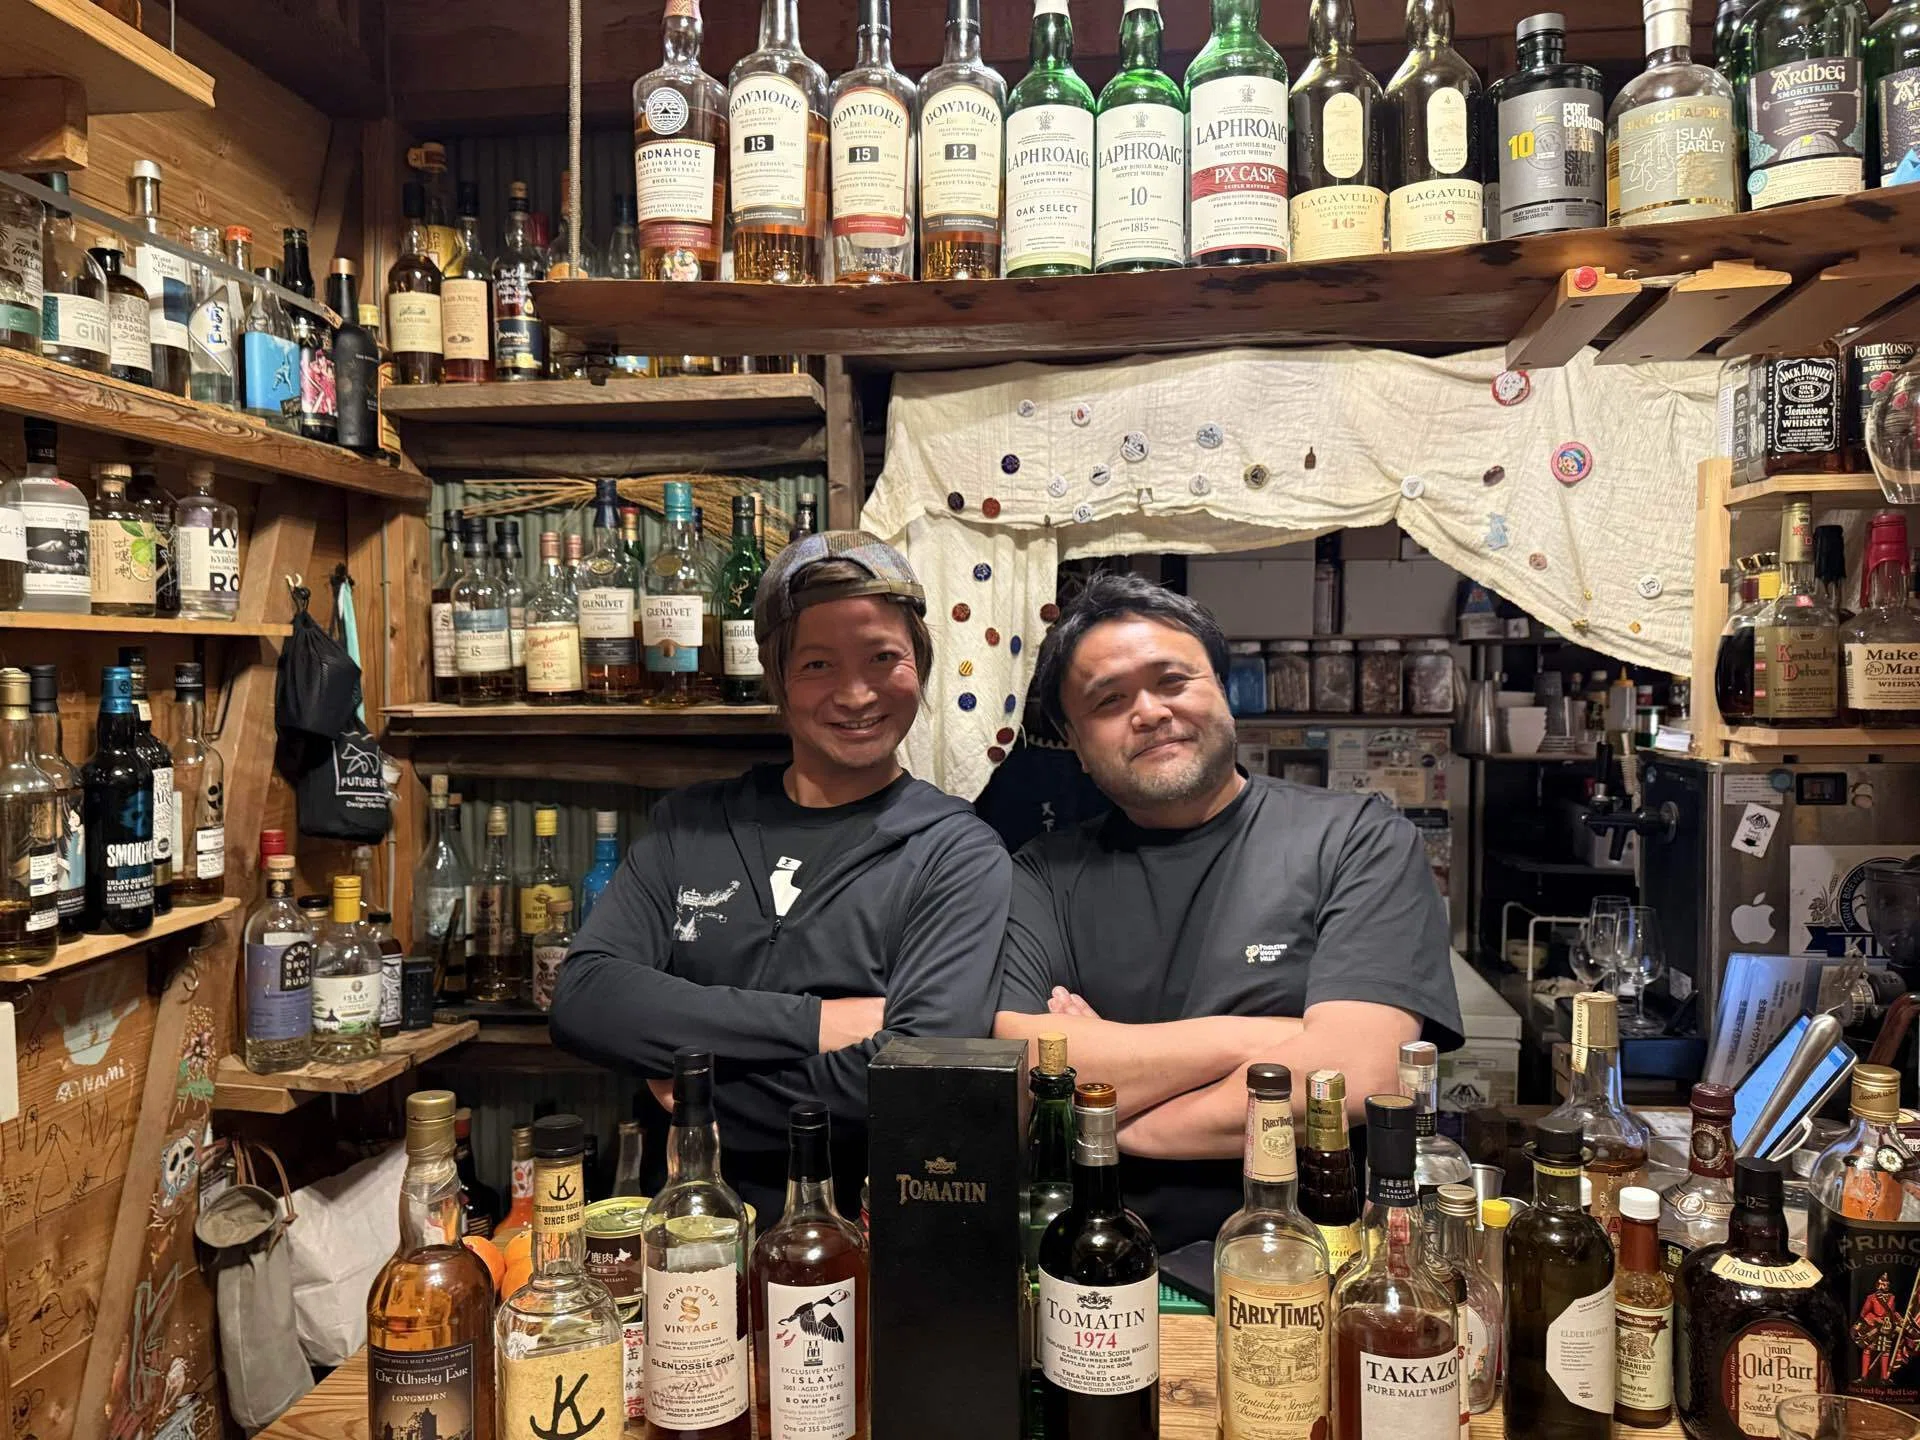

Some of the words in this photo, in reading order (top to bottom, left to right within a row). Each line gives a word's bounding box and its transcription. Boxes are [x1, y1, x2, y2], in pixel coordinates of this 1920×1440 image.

[1776, 84, 1840, 99] SMOKETRAILS
[730, 90, 802, 118] BOWMORE
[1562, 103, 1590, 116] PORT
[832, 103, 904, 129] BOWMORE
[926, 101, 998, 127] BOWMORE
[1197, 118, 1287, 145] LAPHROAIG
[1562, 115, 1604, 135] CHARLOTTE
[1676, 127, 1714, 141] ISLAY
[750, 137, 766, 151] 15
[1262, 143, 1276, 151] MALT
[1508, 130, 1535, 160] 10
[1676, 141, 1726, 154] BARLEY
[638, 149, 701, 162] ARDNAHOE
[855, 149, 871, 161] 15
[952, 145, 969, 159] 12
[1100, 143, 1182, 168] LAPHROAIG
[1008, 147, 1091, 172] LAPHROAIG
[1215, 167, 1237, 184] PX
[1239, 165, 1277, 184] CASK
[1129, 186, 1148, 206] 10
[1301, 193, 1379, 209] LAGAVULIN
[1406, 189, 1482, 203] LAGAVULIN
[1016, 206, 1035, 217] OAK
[1040, 204, 1078, 213] SELECT
[1444, 210, 1456, 224] 8
[1130, 222, 1149, 232] 1815
[1331, 218, 1356, 229] 16
[76, 321, 107, 345] GIN
[1779, 366, 1801, 383] JACK
[1801, 363, 1833, 381] DANIEL'S
[1784, 405, 1828, 416] Tennessee
[1782, 419, 1830, 428] WHISKEY
[582, 600, 624, 609] GLENLIVET
[646, 607, 692, 617] GLENLIVET
[661, 618, 673, 628] 12
[471, 647, 481, 656] 15
[1776, 643, 1836, 663] Kentucky
[1866, 649, 1920, 660] Make
[1783, 662, 1829, 681] Deluxe
[1885, 664, 1920, 674] Mar
[341, 776, 378, 787] FUTURE
[1262, 1118, 1280, 1132] EARLY
[896, 1174, 987, 1205] TOMATIN
[544, 1215, 565, 1226] SINCE
[591, 1251, 614, 1264] 鹿肉
[1722, 1261, 1760, 1281] Grand
[1763, 1269, 1784, 1283] Old
[1785, 1267, 1811, 1285] Parr
[662, 1285, 720, 1311] SIGNATORY
[1046, 1297, 1145, 1329] TOMATIN
[1229, 1295, 1278, 1331] EARLY
[1274, 1301, 1325, 1331] TIMES
[664, 1321, 718, 1333] VINTAGE
[1561, 1329, 1585, 1338] ELDER
[1074, 1331, 1117, 1349] 1974
[1061, 1352, 1078, 1360] CASK
[1068, 1346, 1088, 1356] SINGLE
[1763, 1344, 1791, 1358] Grand
[651, 1358, 713, 1371] GLENLOSSIE
[714, 1354, 735, 1366] 2012
[1060, 1356, 1087, 1368] BOTTLED
[1617, 1359, 1651, 1371] HABANERO
[1743, 1353, 1773, 1379] Old
[1773, 1355, 1814, 1380] Parr
[781, 1366, 820, 1375] EXCLUSIVE
[823, 1363, 845, 1373] MALTS
[1062, 1369, 1107, 1382] TREASURED
[1366, 1356, 1458, 1384] TAKAZO
[375, 1368, 393, 1384] The
[396, 1373, 442, 1386] Whisky
[446, 1367, 468, 1383] Fair
[792, 1374, 834, 1384] ISLAY
[684, 1381, 698, 1393] 12
[826, 1381, 844, 1390] YEARS
[1367, 1384, 1396, 1397] PURE
[1398, 1388, 1428, 1398] MALT
[1772, 1383, 1783, 1393] 12
[1887, 1387, 1901, 1395] Red
[392, 1391, 447, 1402] LONGMORN
[786, 1393, 841, 1404] BOWMORE
[1234, 1389, 1282, 1411] Kentucky
[1743, 1401, 1772, 1412] Scotch
[1236, 1405, 1283, 1422] Bourbon
[822, 1422, 844, 1431] bottles
